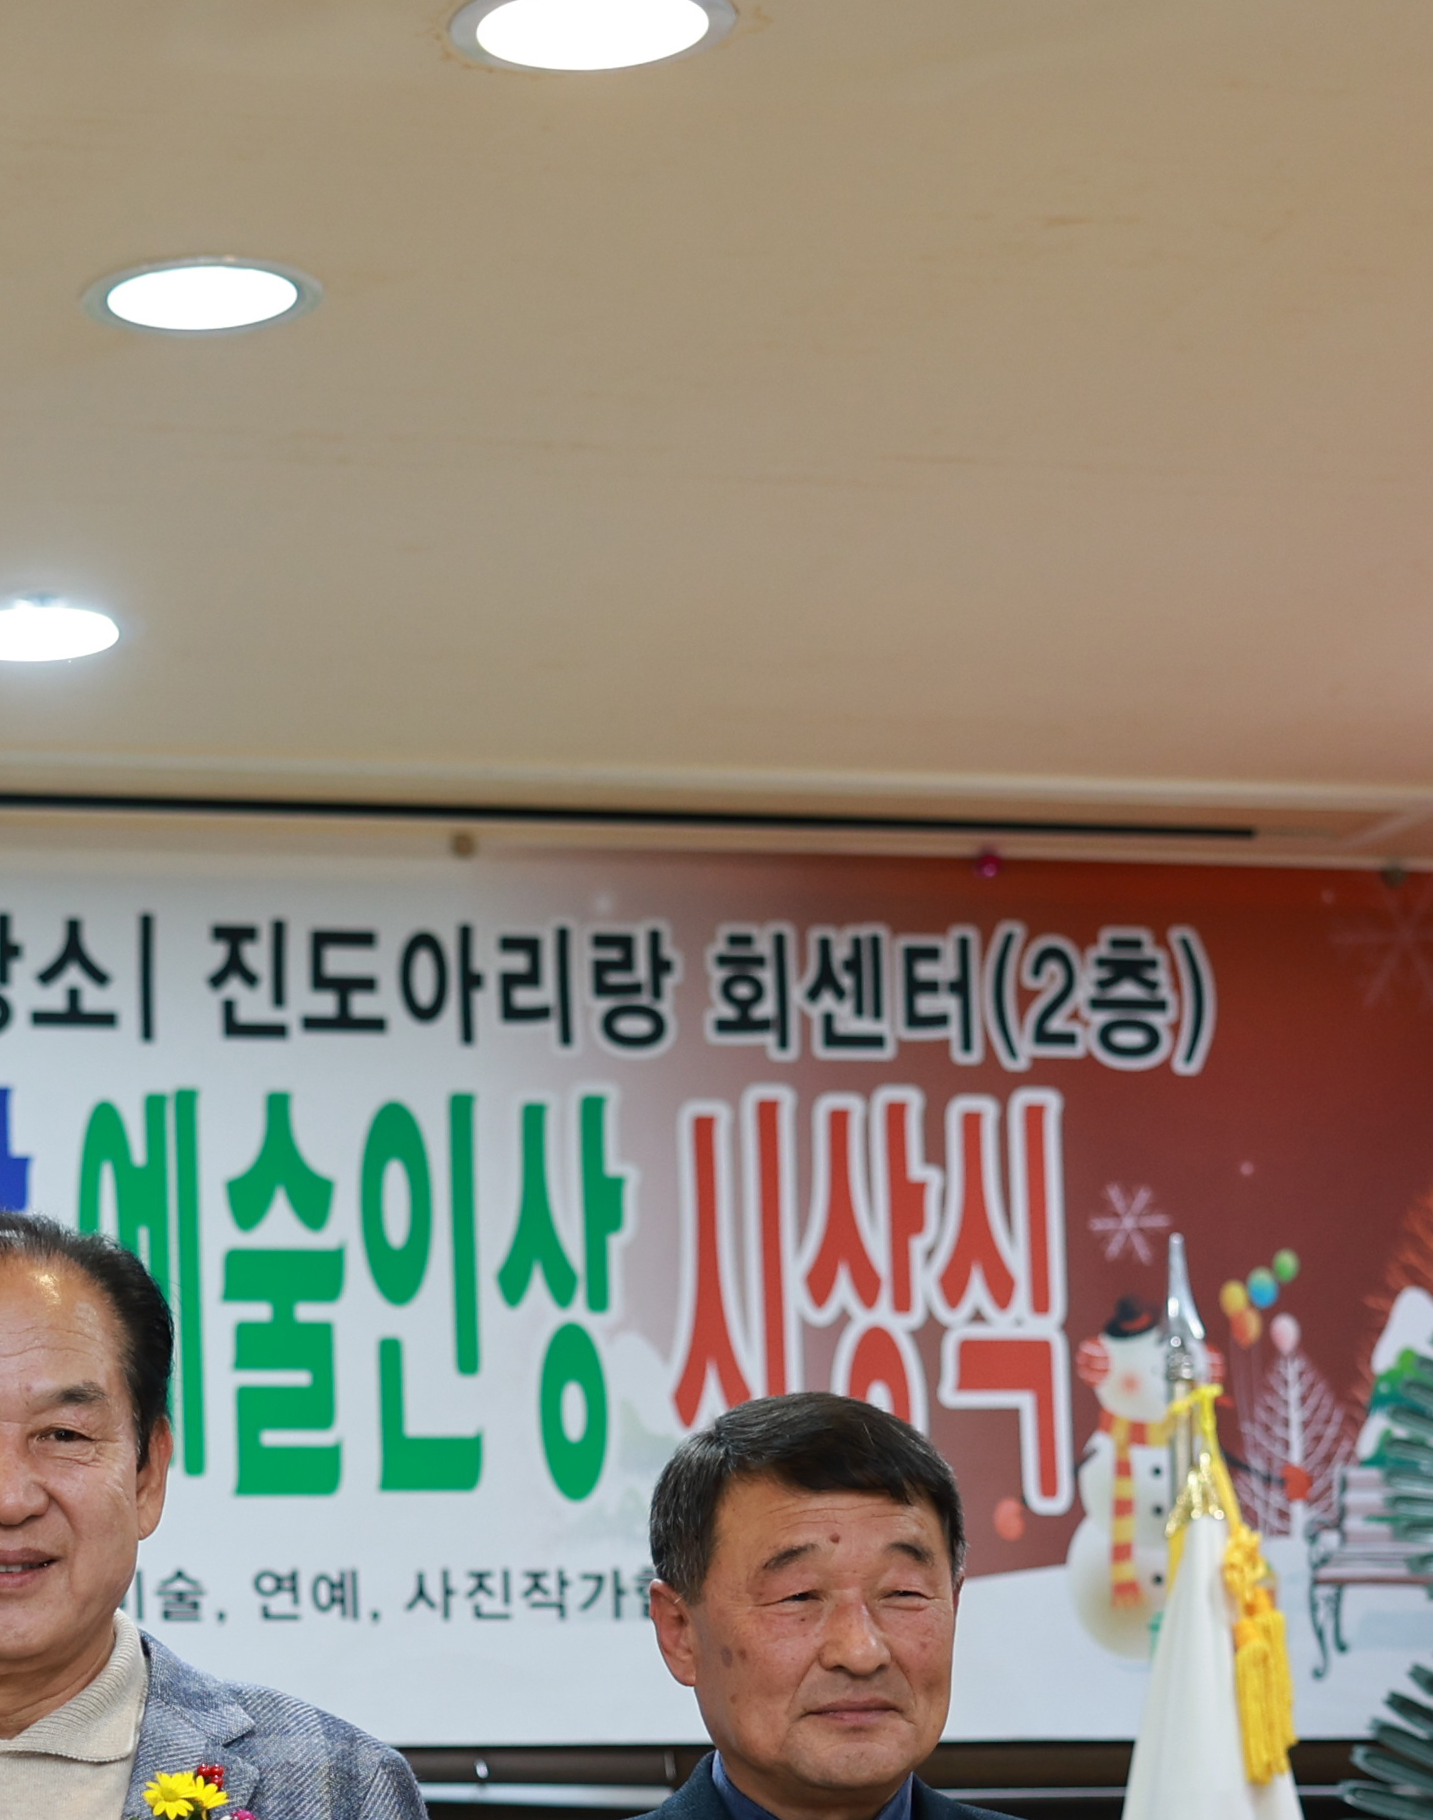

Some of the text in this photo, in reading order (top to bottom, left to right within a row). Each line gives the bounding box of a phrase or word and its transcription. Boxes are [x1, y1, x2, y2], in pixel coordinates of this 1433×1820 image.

[209, 922, 673, 1046] 진도아리랑
[713, 922, 1214, 1072] 회센터(2층)
[674, 1099, 1059, 1499] 시상식
[252, 1567, 381, 1625] 연예,
[405, 1567, 653, 1623] 사진작가
